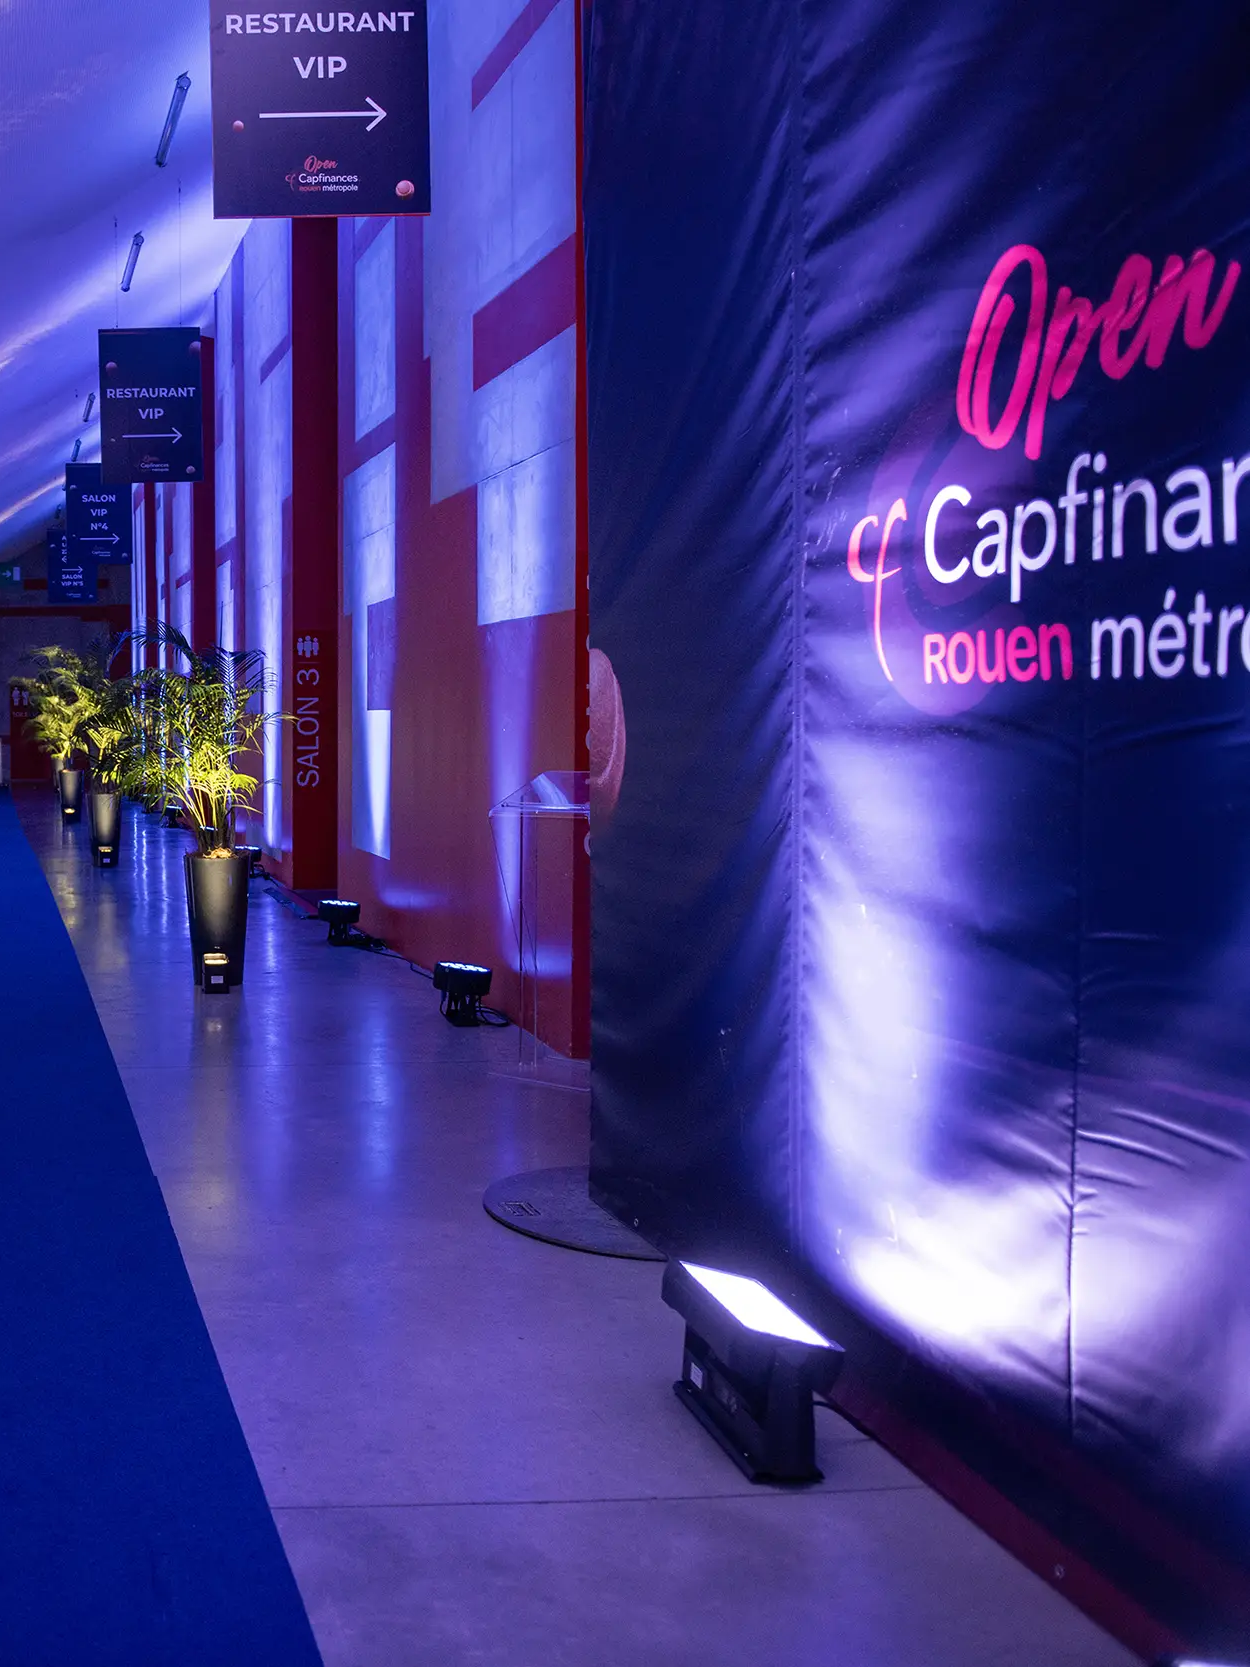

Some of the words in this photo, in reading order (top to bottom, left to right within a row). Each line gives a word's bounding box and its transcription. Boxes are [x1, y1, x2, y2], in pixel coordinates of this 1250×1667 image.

[225, 12, 415, 34] RESTAURANT
[293, 56, 347, 79] VIP
[304, 155, 338, 173] Open
[298, 173, 359, 185] Capfinances
[322, 184, 359, 193] métropole
[956, 244, 1241, 460] Open
[106, 387, 196, 399] RESTAURANT
[138, 408, 164, 419] VIP
[81, 494, 116, 503] SALON
[90, 508, 108, 516] VIP
[90, 522, 109, 531] N°4
[1091, 586, 1250, 681] métr
[297, 668, 320, 686] 3
[297, 697, 320, 788] SALON
